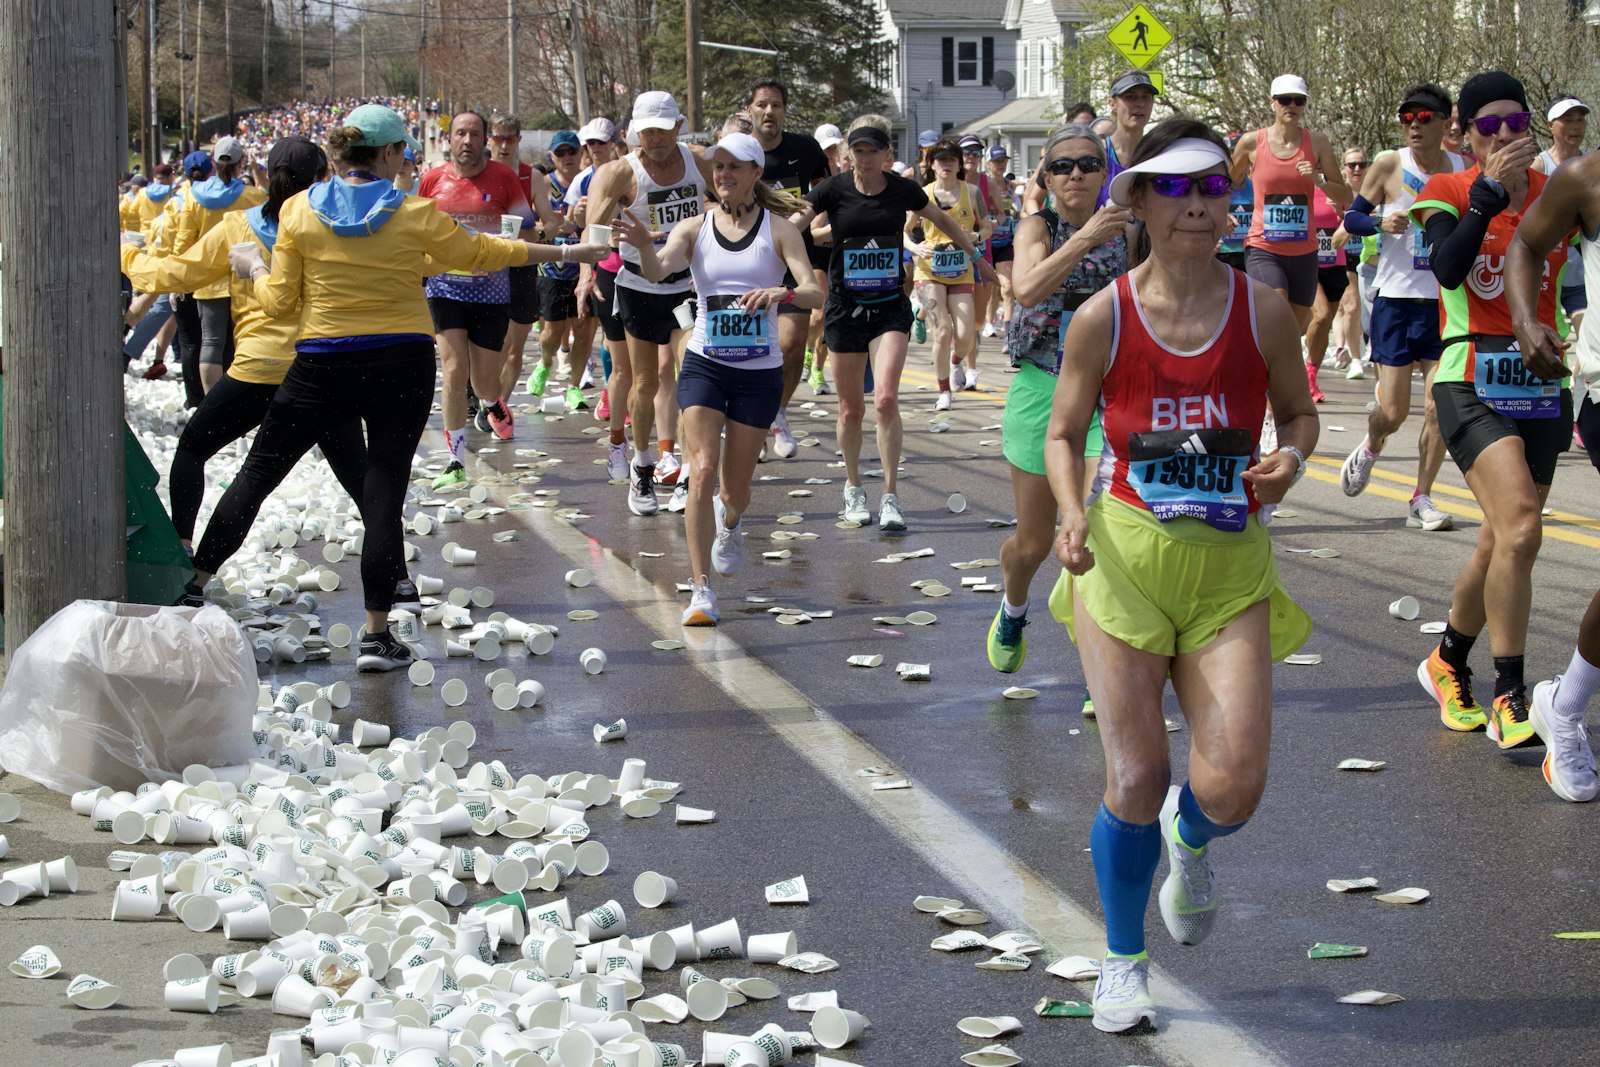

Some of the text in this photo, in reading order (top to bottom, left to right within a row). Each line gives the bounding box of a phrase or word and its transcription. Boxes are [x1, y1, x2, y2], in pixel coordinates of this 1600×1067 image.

[657, 200, 698, 224] 15793
[1268, 208, 1304, 224] 19842
[849, 252, 894, 270] 20062
[936, 252, 964, 266] 20758
[712, 314, 761, 336] 18821
[1484, 357, 1554, 386] 1992
[1152, 392, 1230, 432] BEN
[1144, 455, 1237, 494] 19939
[1171, 504, 1207, 513] BOSTON
